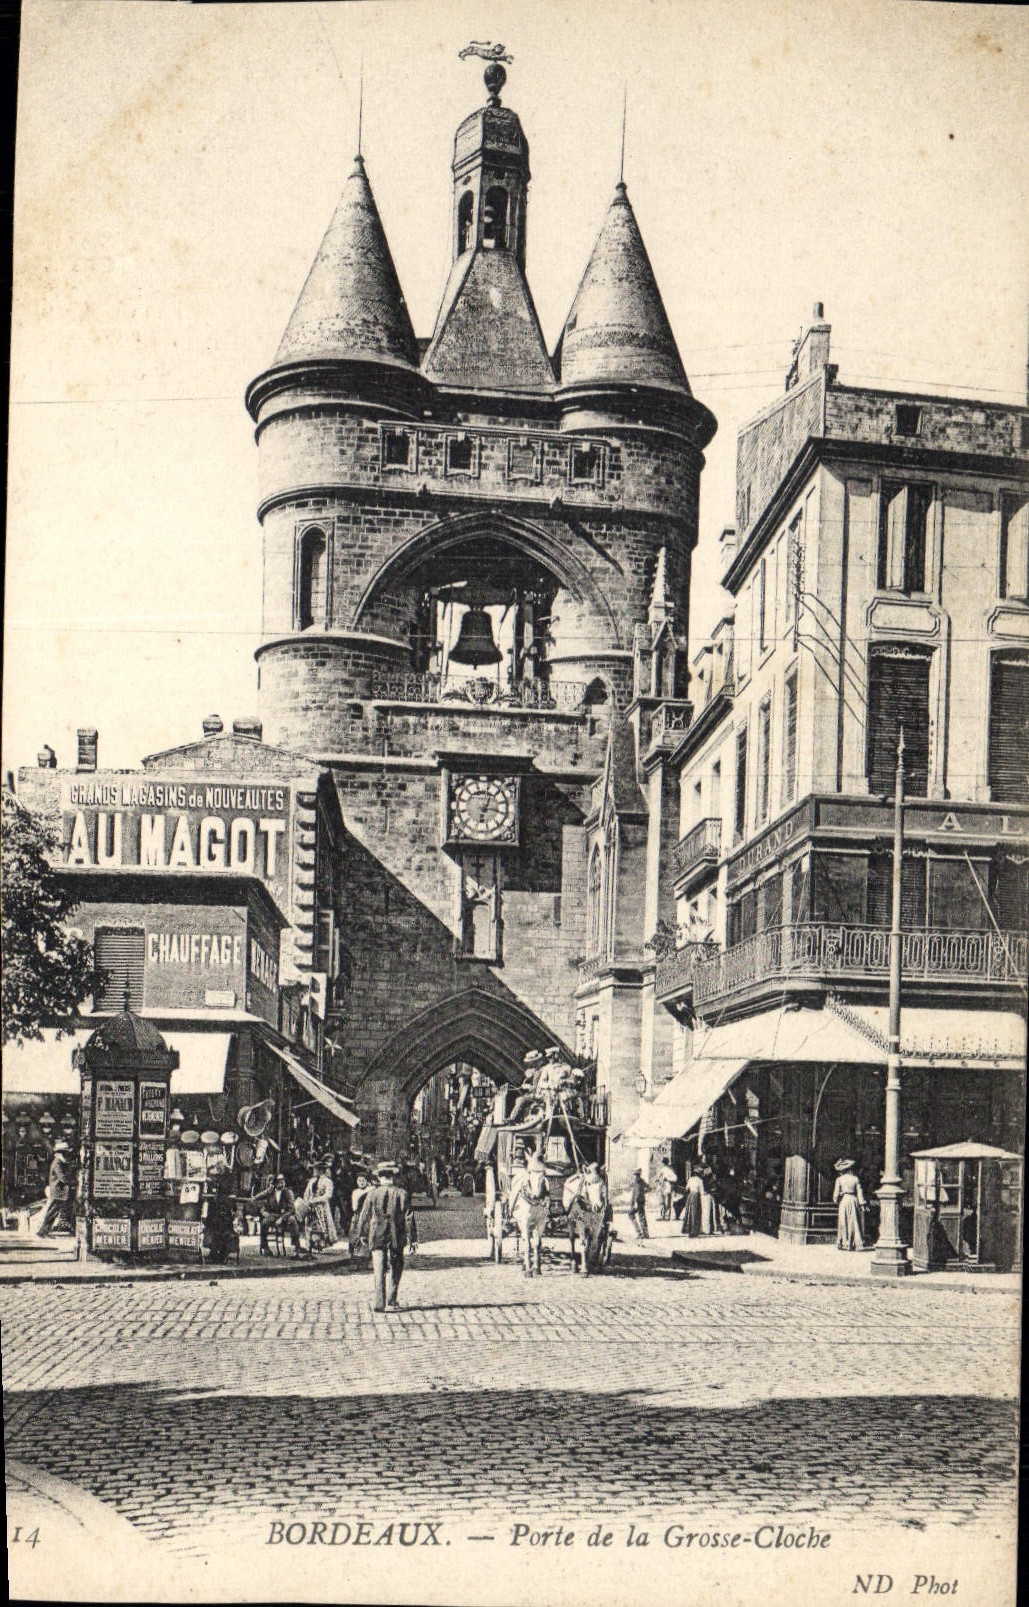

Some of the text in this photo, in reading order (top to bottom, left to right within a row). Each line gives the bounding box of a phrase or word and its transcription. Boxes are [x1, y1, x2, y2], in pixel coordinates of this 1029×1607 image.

[70, 784, 118, 806] GRANDS
[121, 785, 187, 808] MAGASINS
[188, 793, 203, 808] de
[67, 811, 286, 876] AU MAGOT
[739, 820, 793, 872] DURAND
[148, 932, 242, 964] CHAUFFAGE
[96, 1235, 127, 1245] MENIER
[169, 1237, 197, 1247] MENIER
